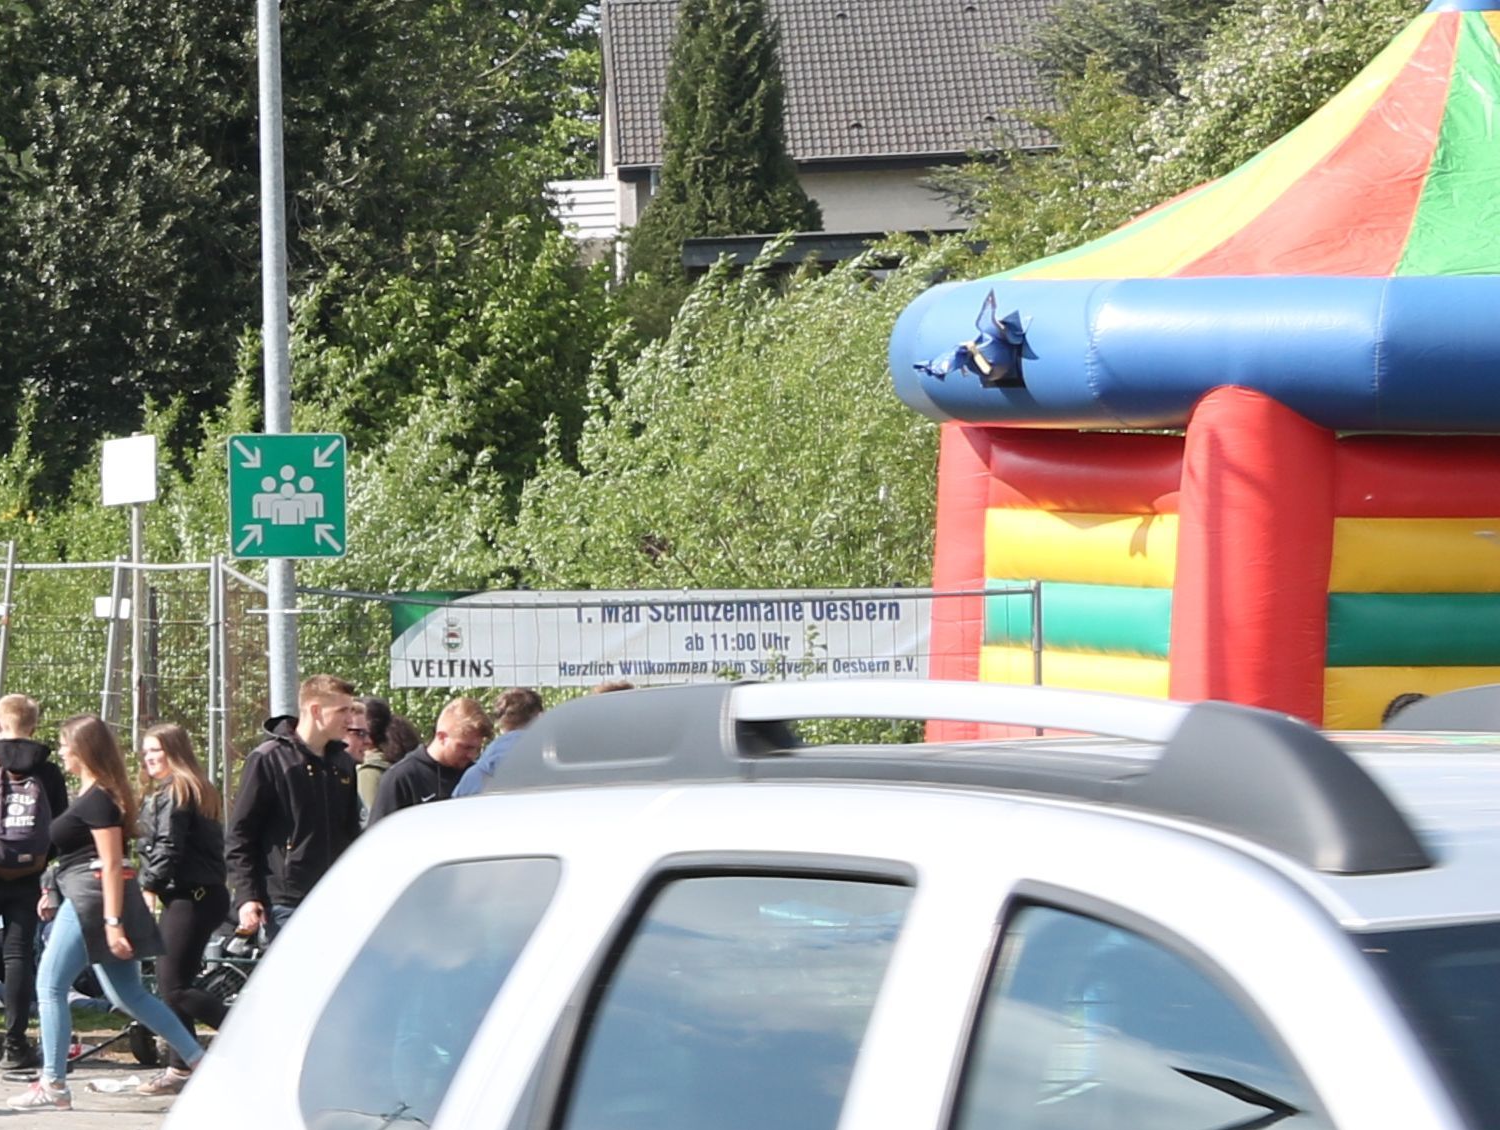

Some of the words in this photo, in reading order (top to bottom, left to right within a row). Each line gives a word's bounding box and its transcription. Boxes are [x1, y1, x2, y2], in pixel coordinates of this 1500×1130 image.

[577, 598, 593, 623] 1.
[602, 598, 641, 623] Mai
[811, 598, 901, 622] Oesbern
[685, 635, 704, 651] ab
[711, 632, 756, 651] 11:00
[762, 632, 791, 651] Uhr
[411, 659, 494, 678] VELTINS
[559, 661, 614, 676] Herzlich
[620, 659, 708, 676] Willkommen
[832, 657, 890, 673] Oesbern
[894, 656, 918, 673] e.V.
